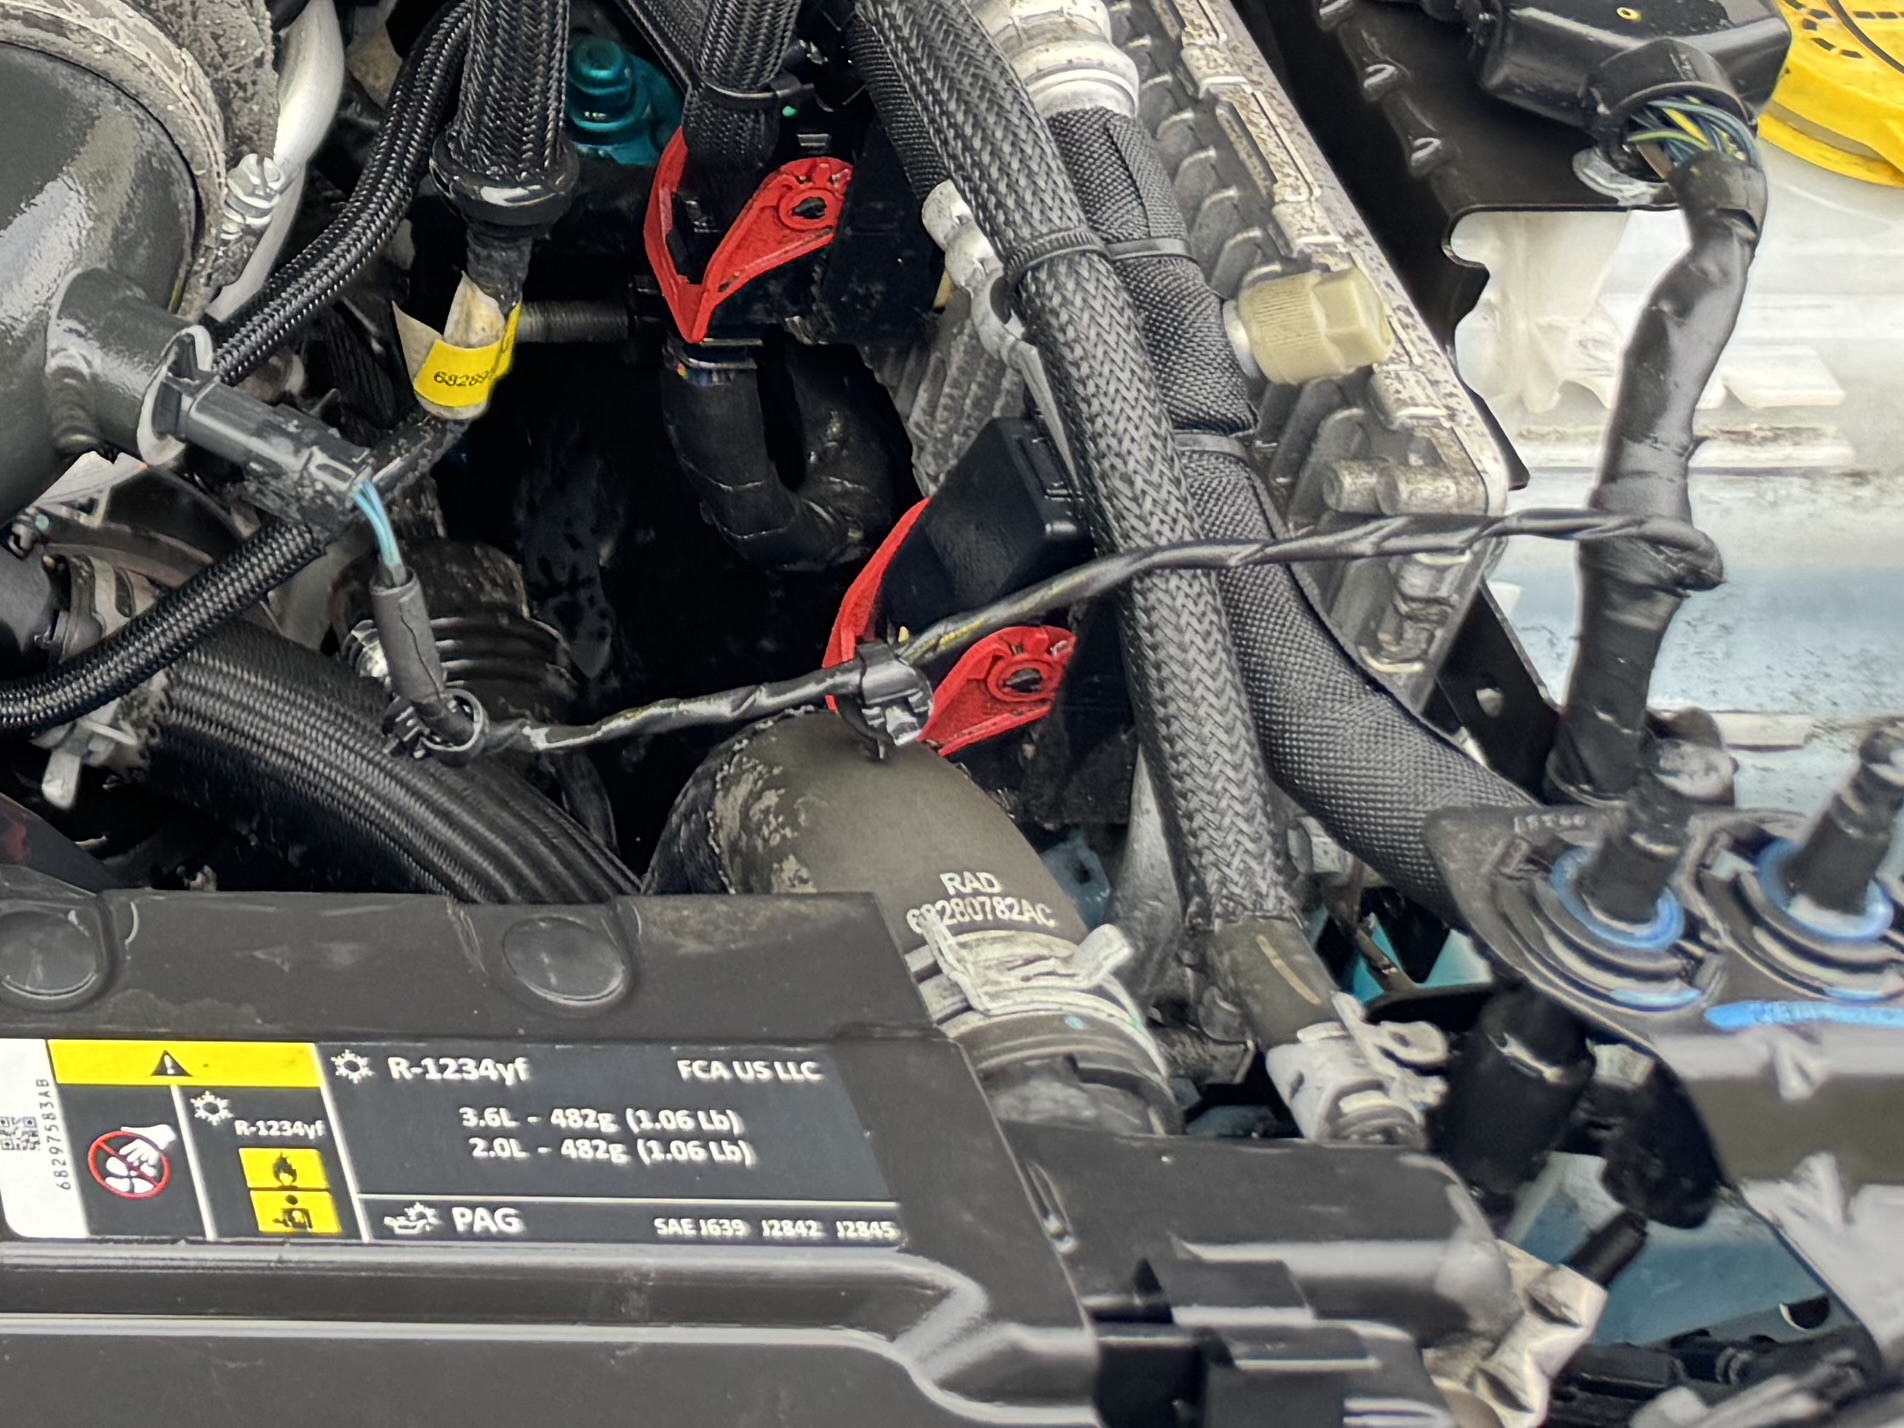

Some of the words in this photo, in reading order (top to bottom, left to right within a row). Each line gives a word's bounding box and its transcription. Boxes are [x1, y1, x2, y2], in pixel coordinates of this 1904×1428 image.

[940, 871, 1002, 895] RAD
[388, 1056, 531, 1085] R-1234yf
[677, 1059, 732, 1081] FCA
[732, 1060, 774, 1082] US
[774, 1060, 824, 1082] LLC
[36, 1078, 71, 1190] 68297583AB
[235, 1119, 327, 1142] R-1234yf
[459, 1107, 519, 1128] 3.6L
[550, 1108, 620, 1133] 482g
[625, 1108, 696, 1134] (1.06
[697, 1109, 745, 1136] Lb)
[469, 1137, 530, 1158] 2.0L
[560, 1138, 630, 1164] 482g
[637, 1139, 707, 1165] (1.06
[708, 1140, 757, 1168] Lb)
[451, 1207, 526, 1234] PAG
[653, 1218, 697, 1237] SAE
